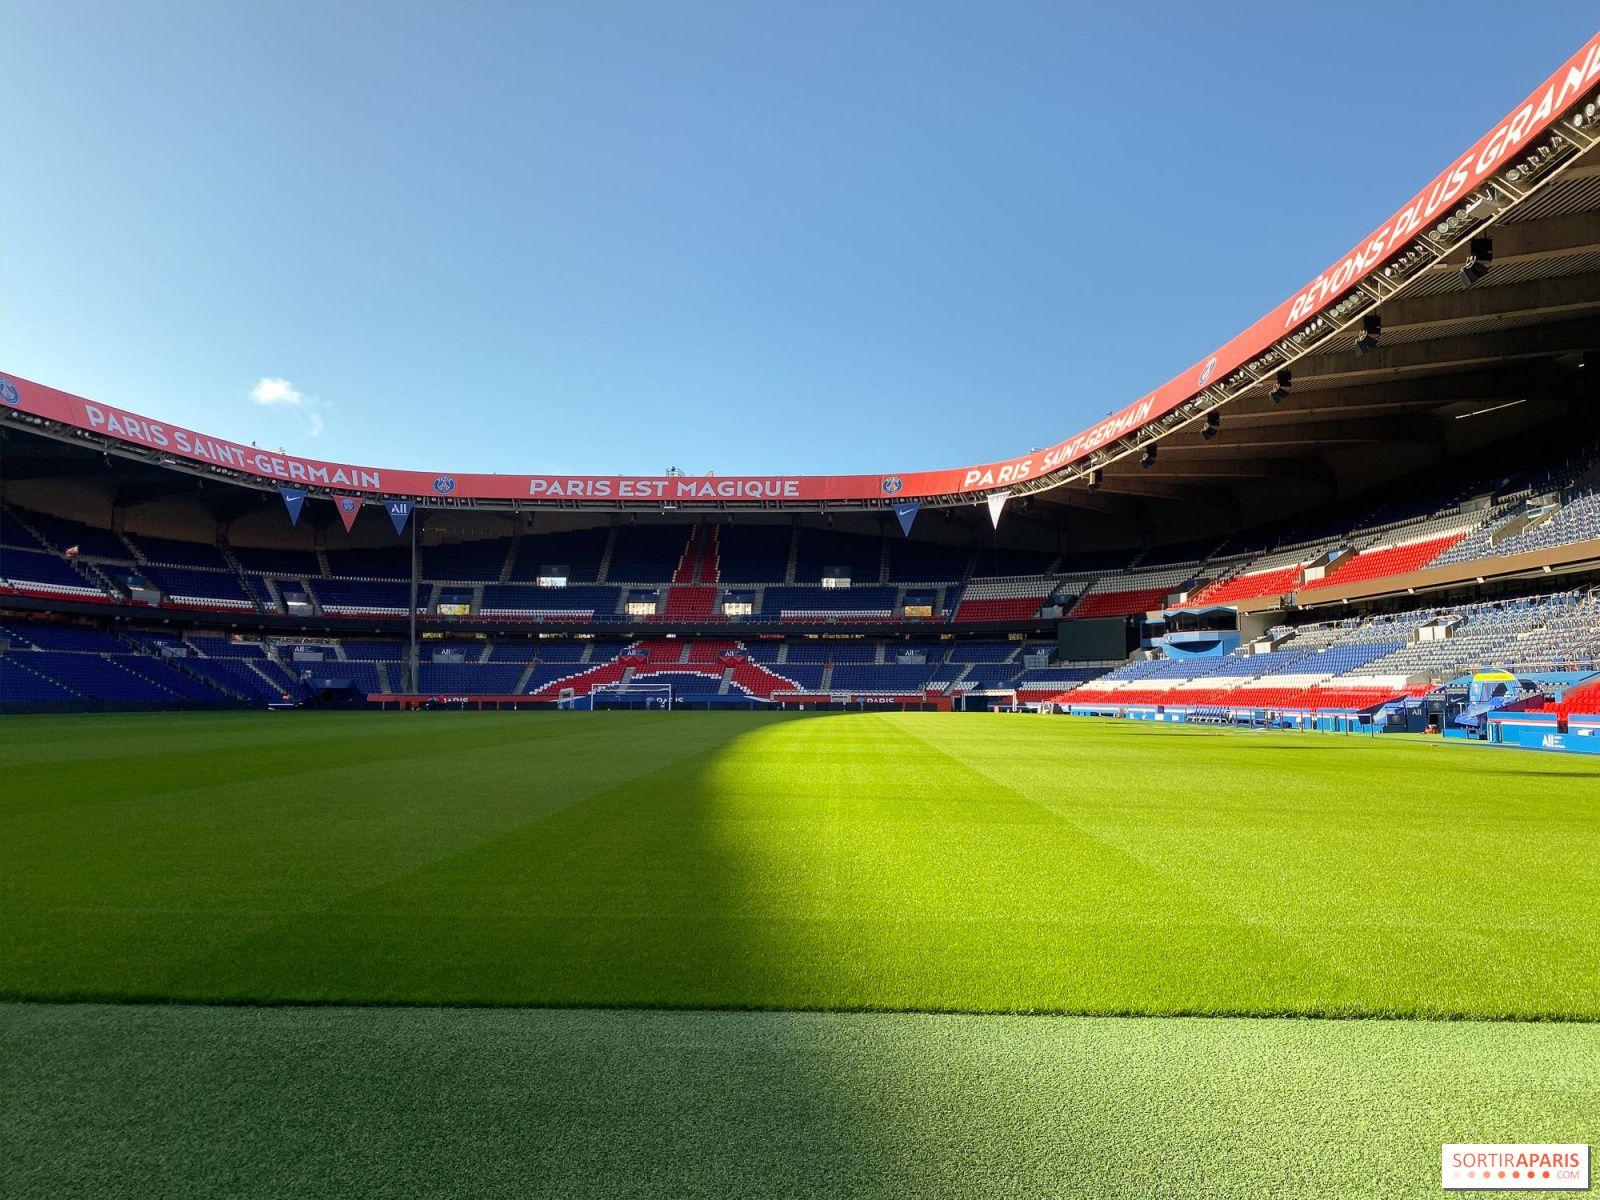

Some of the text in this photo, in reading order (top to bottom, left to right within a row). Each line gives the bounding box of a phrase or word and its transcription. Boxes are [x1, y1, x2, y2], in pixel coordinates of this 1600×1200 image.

[1387, 155, 1474, 249] PLUS
[85, 404, 381, 489] PARIS SAINT-GERMAIN
[964, 397, 1154, 488] PARIS SAINT-GERMAIN
[529, 479, 800, 499] PARIS EST MAGIQUE
